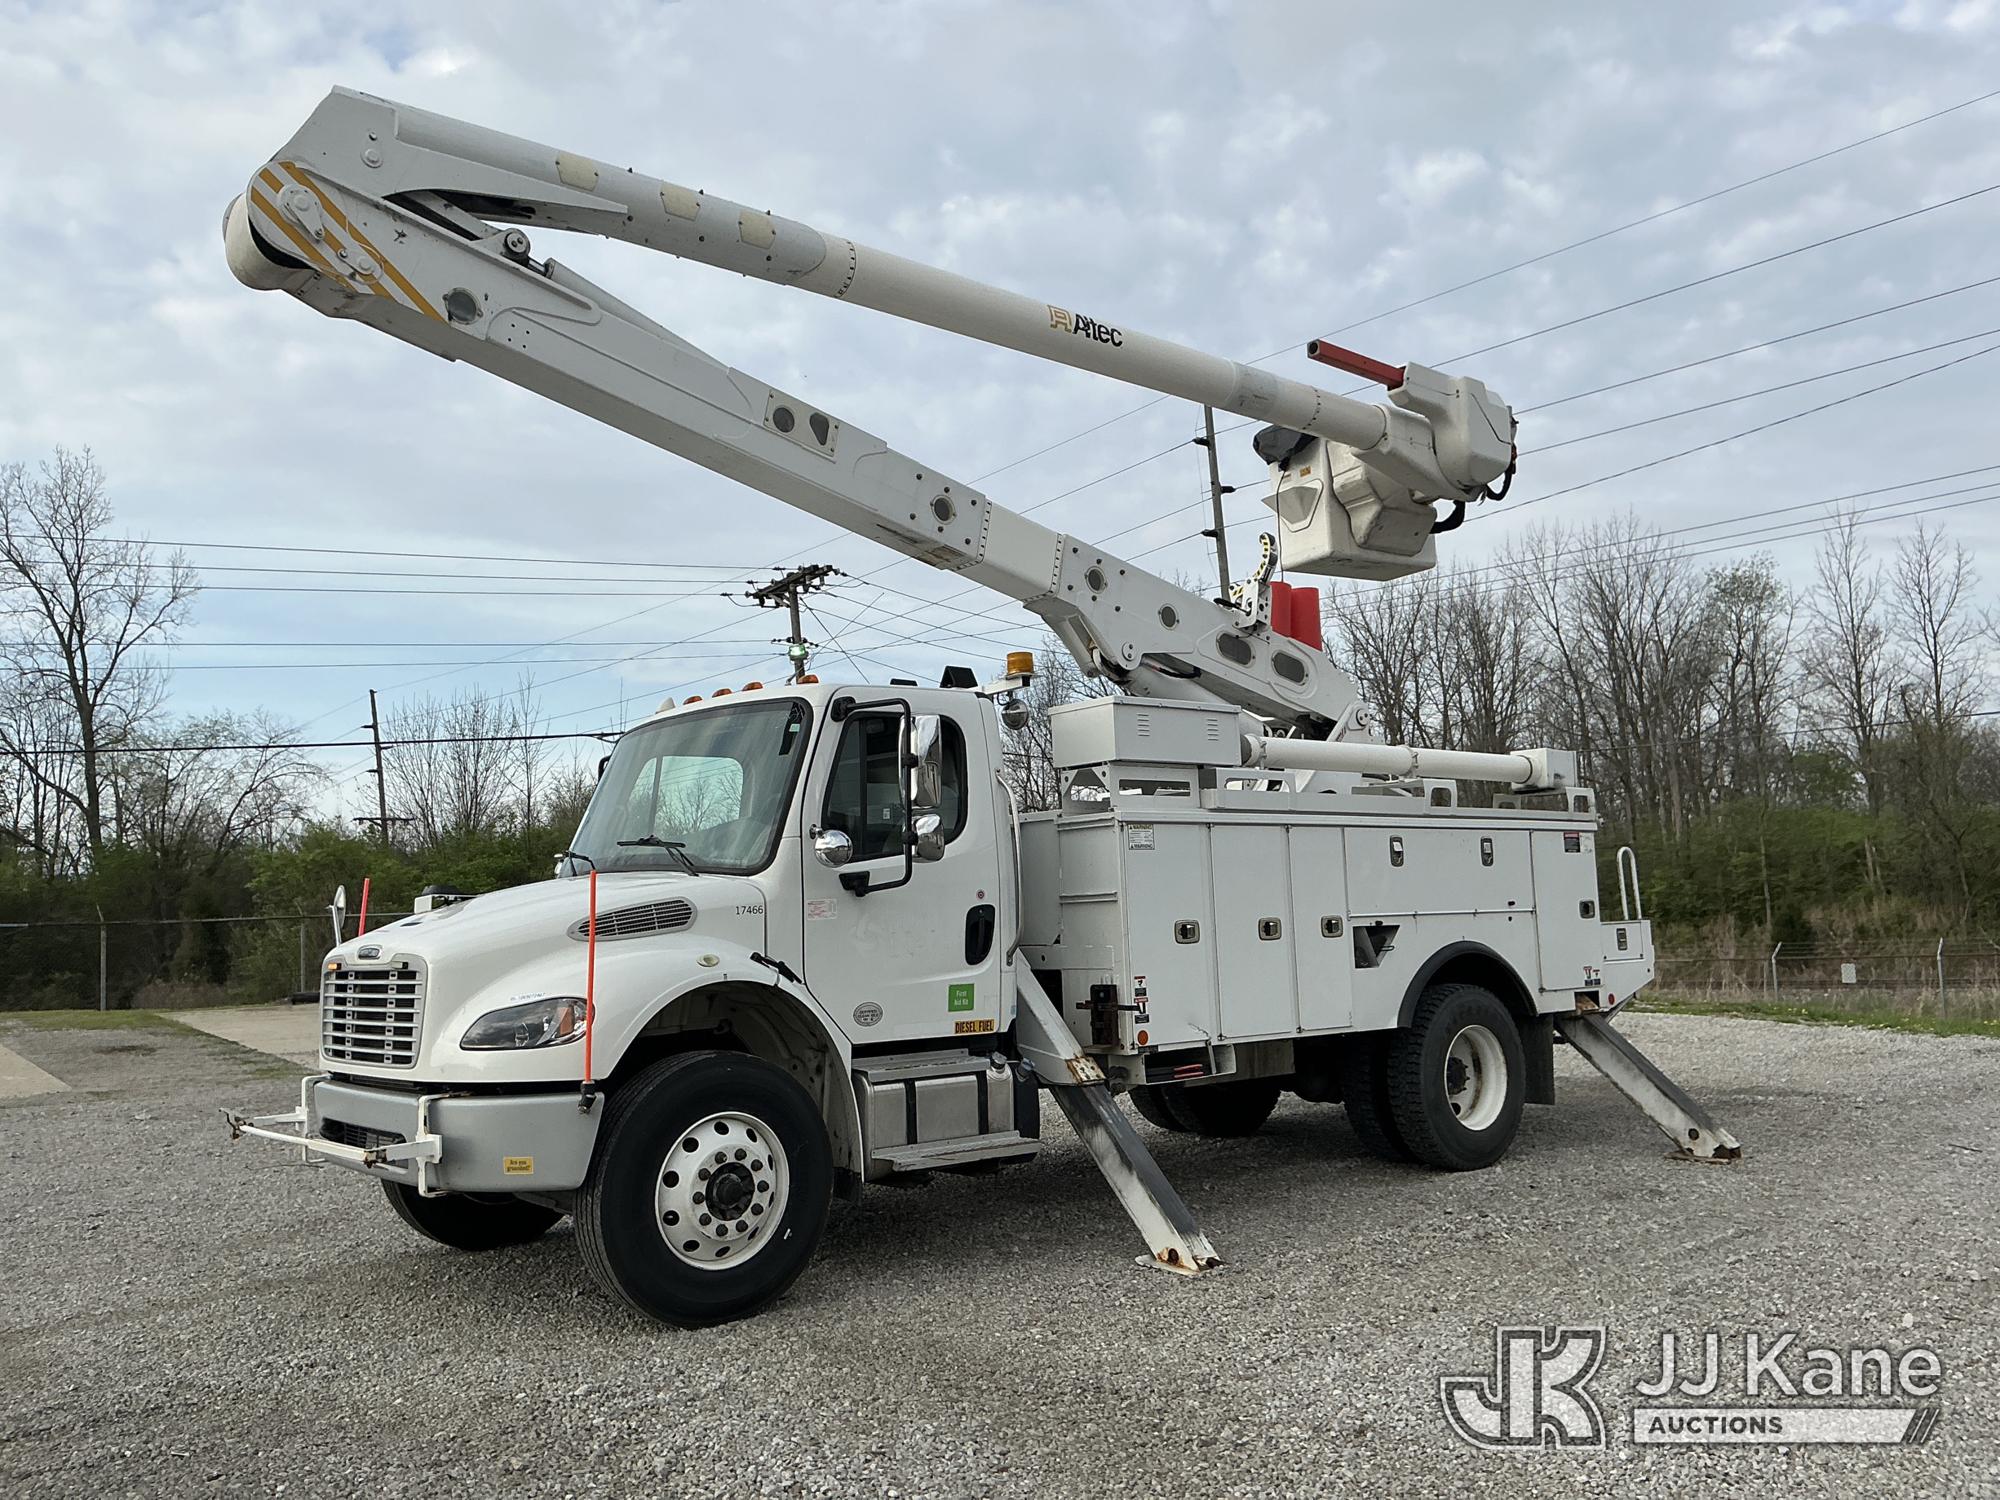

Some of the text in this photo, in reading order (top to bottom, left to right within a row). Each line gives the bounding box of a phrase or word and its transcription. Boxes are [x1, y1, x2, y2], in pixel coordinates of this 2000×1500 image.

[1073, 313, 1123, 347] Altec
[735, 905, 764, 915] 17466
[955, 1019, 994, 1034] DIESEL FUEL
